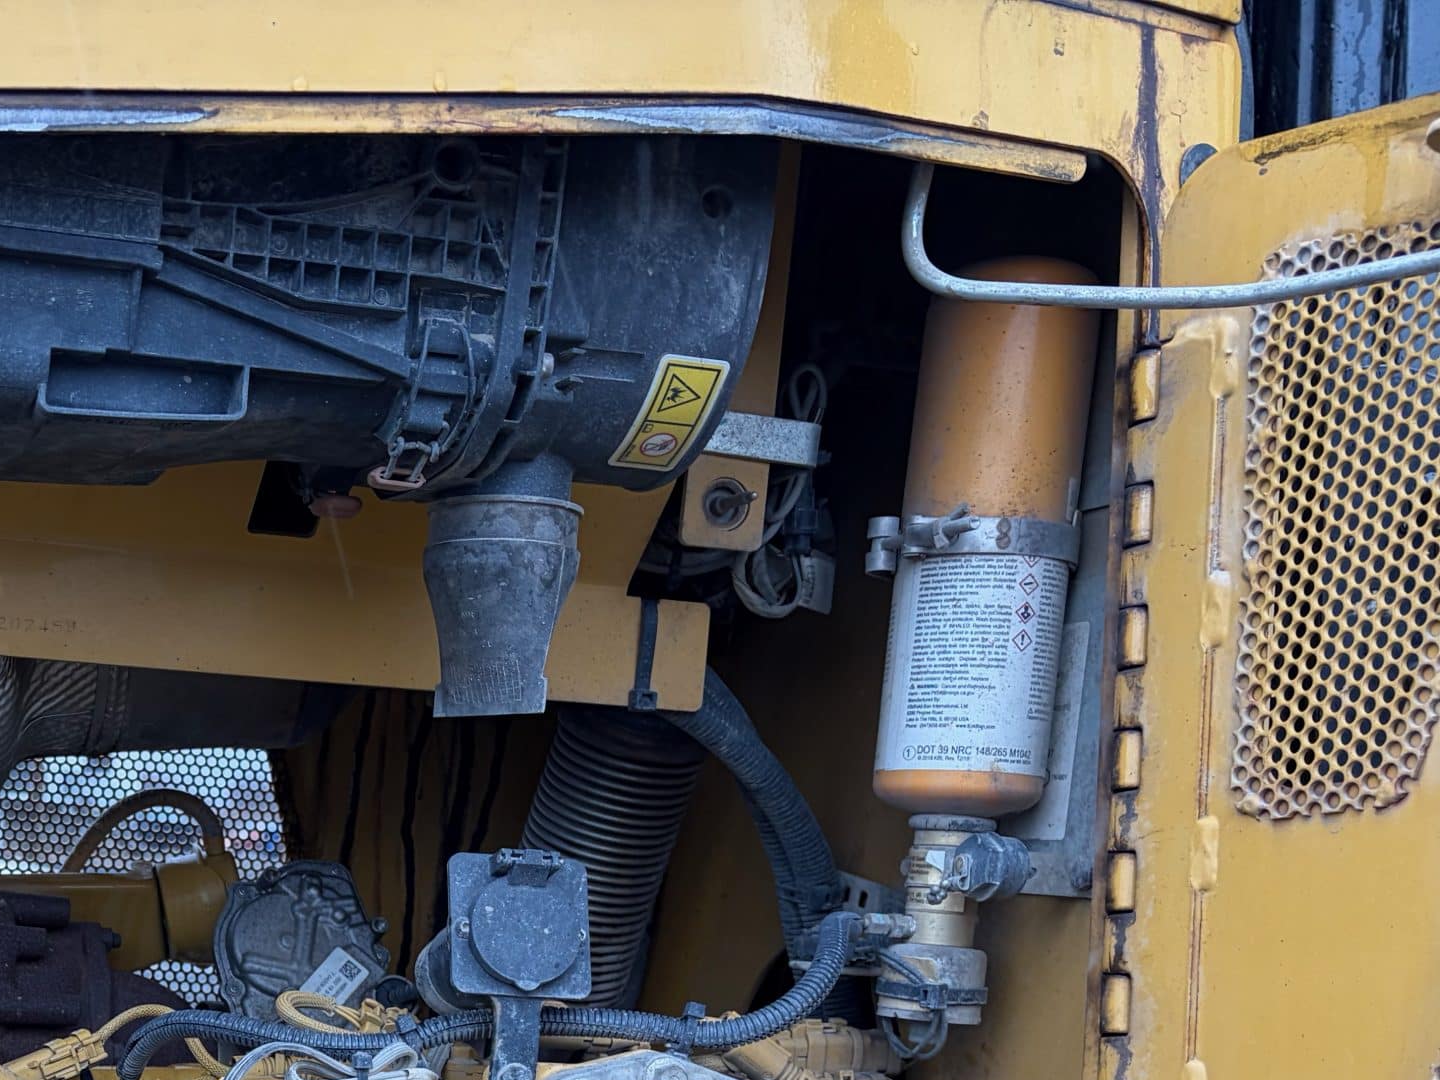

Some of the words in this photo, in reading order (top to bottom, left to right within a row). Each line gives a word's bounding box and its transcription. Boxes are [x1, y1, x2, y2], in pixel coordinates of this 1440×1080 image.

[917, 745, 936, 754] DOT
[937, 745, 949, 754] 39
[951, 745, 972, 755] NRC
